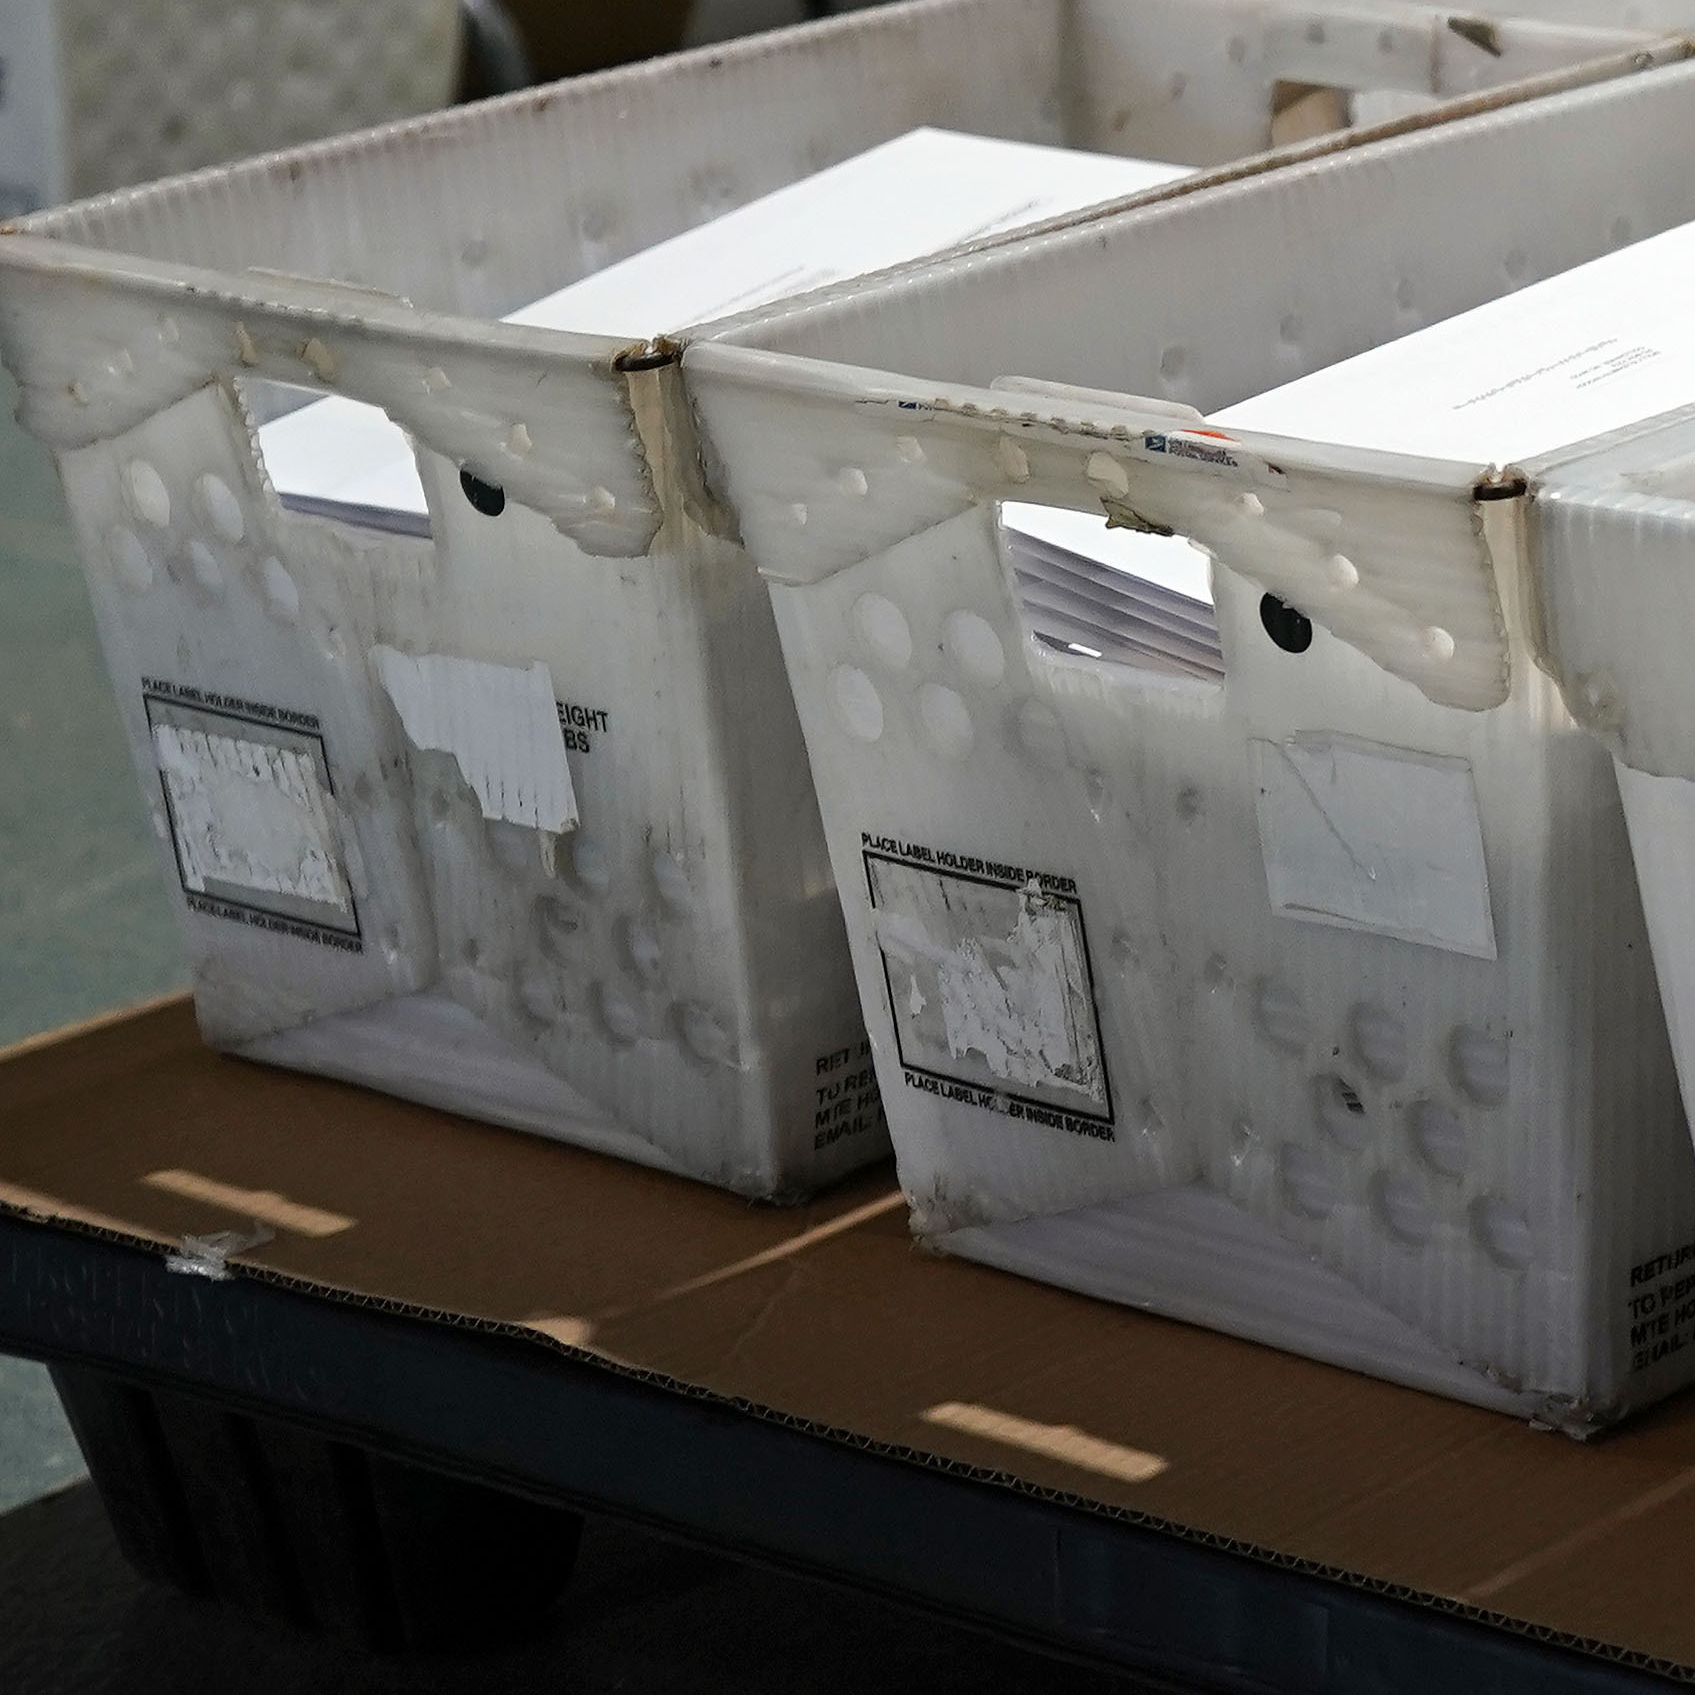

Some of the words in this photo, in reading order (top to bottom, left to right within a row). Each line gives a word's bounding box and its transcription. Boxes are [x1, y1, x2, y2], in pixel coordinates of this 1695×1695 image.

[861, 832, 897, 854] PLACE
[898, 841, 936, 863] LABEL
[936, 851, 986, 874] HOLDER
[986, 862, 1025, 883] INSIDE
[1025, 869, 1078, 894] BORDER
[904, 1072, 940, 1095] PLACE
[940, 1082, 978, 1106] LABEL
[977, 1092, 1025, 1121] HOER
[1026, 1107, 1065, 1132] INSIDE
[1065, 1117, 1116, 1143] BORDER
[1628, 1293, 1656, 1319] TO
[1630, 1312, 1670, 1348] MTE
